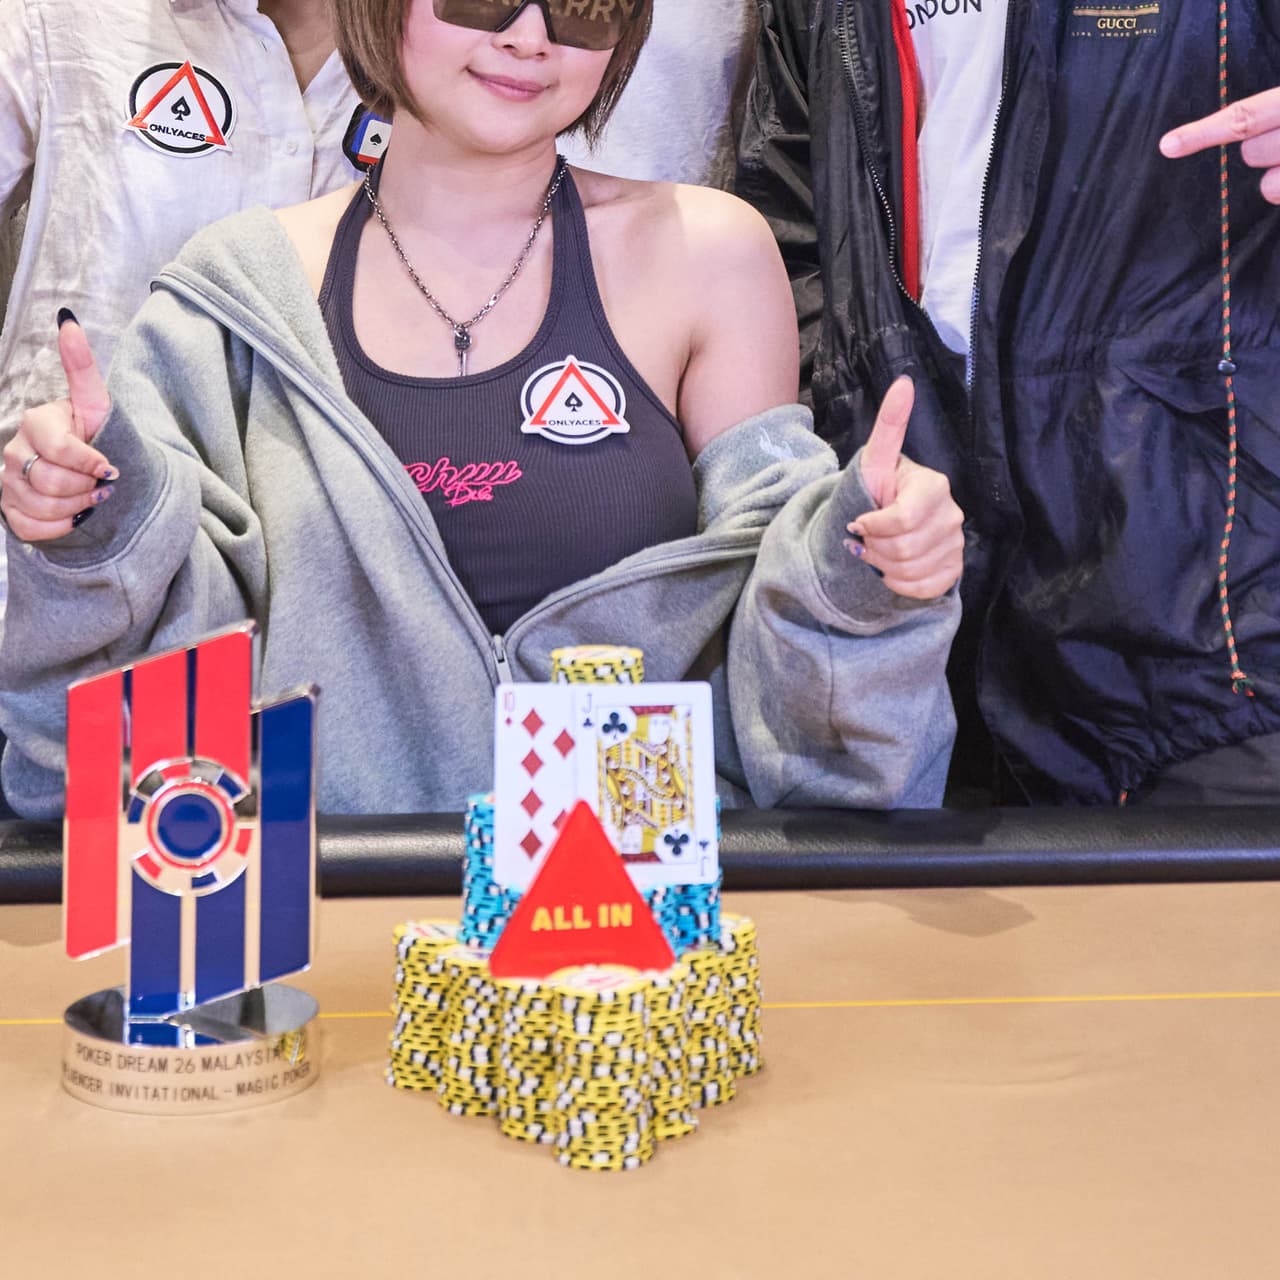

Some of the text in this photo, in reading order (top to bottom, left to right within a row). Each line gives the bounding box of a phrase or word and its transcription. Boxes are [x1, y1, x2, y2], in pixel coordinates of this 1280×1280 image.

[1097, 17, 1137, 29] GUCCI
[148, 122, 208, 143] ONLYACES
[547, 418, 602, 428] ONLYACES
[531, 903, 633, 931] ALL IN
[75, 1042, 112, 1067] POKER
[117, 1053, 169, 1072] DREAM
[174, 1058, 196, 1074] 26
[109, 1083, 219, 1101] INVITATIONAL
[235, 1071, 280, 1096] MAGIC
